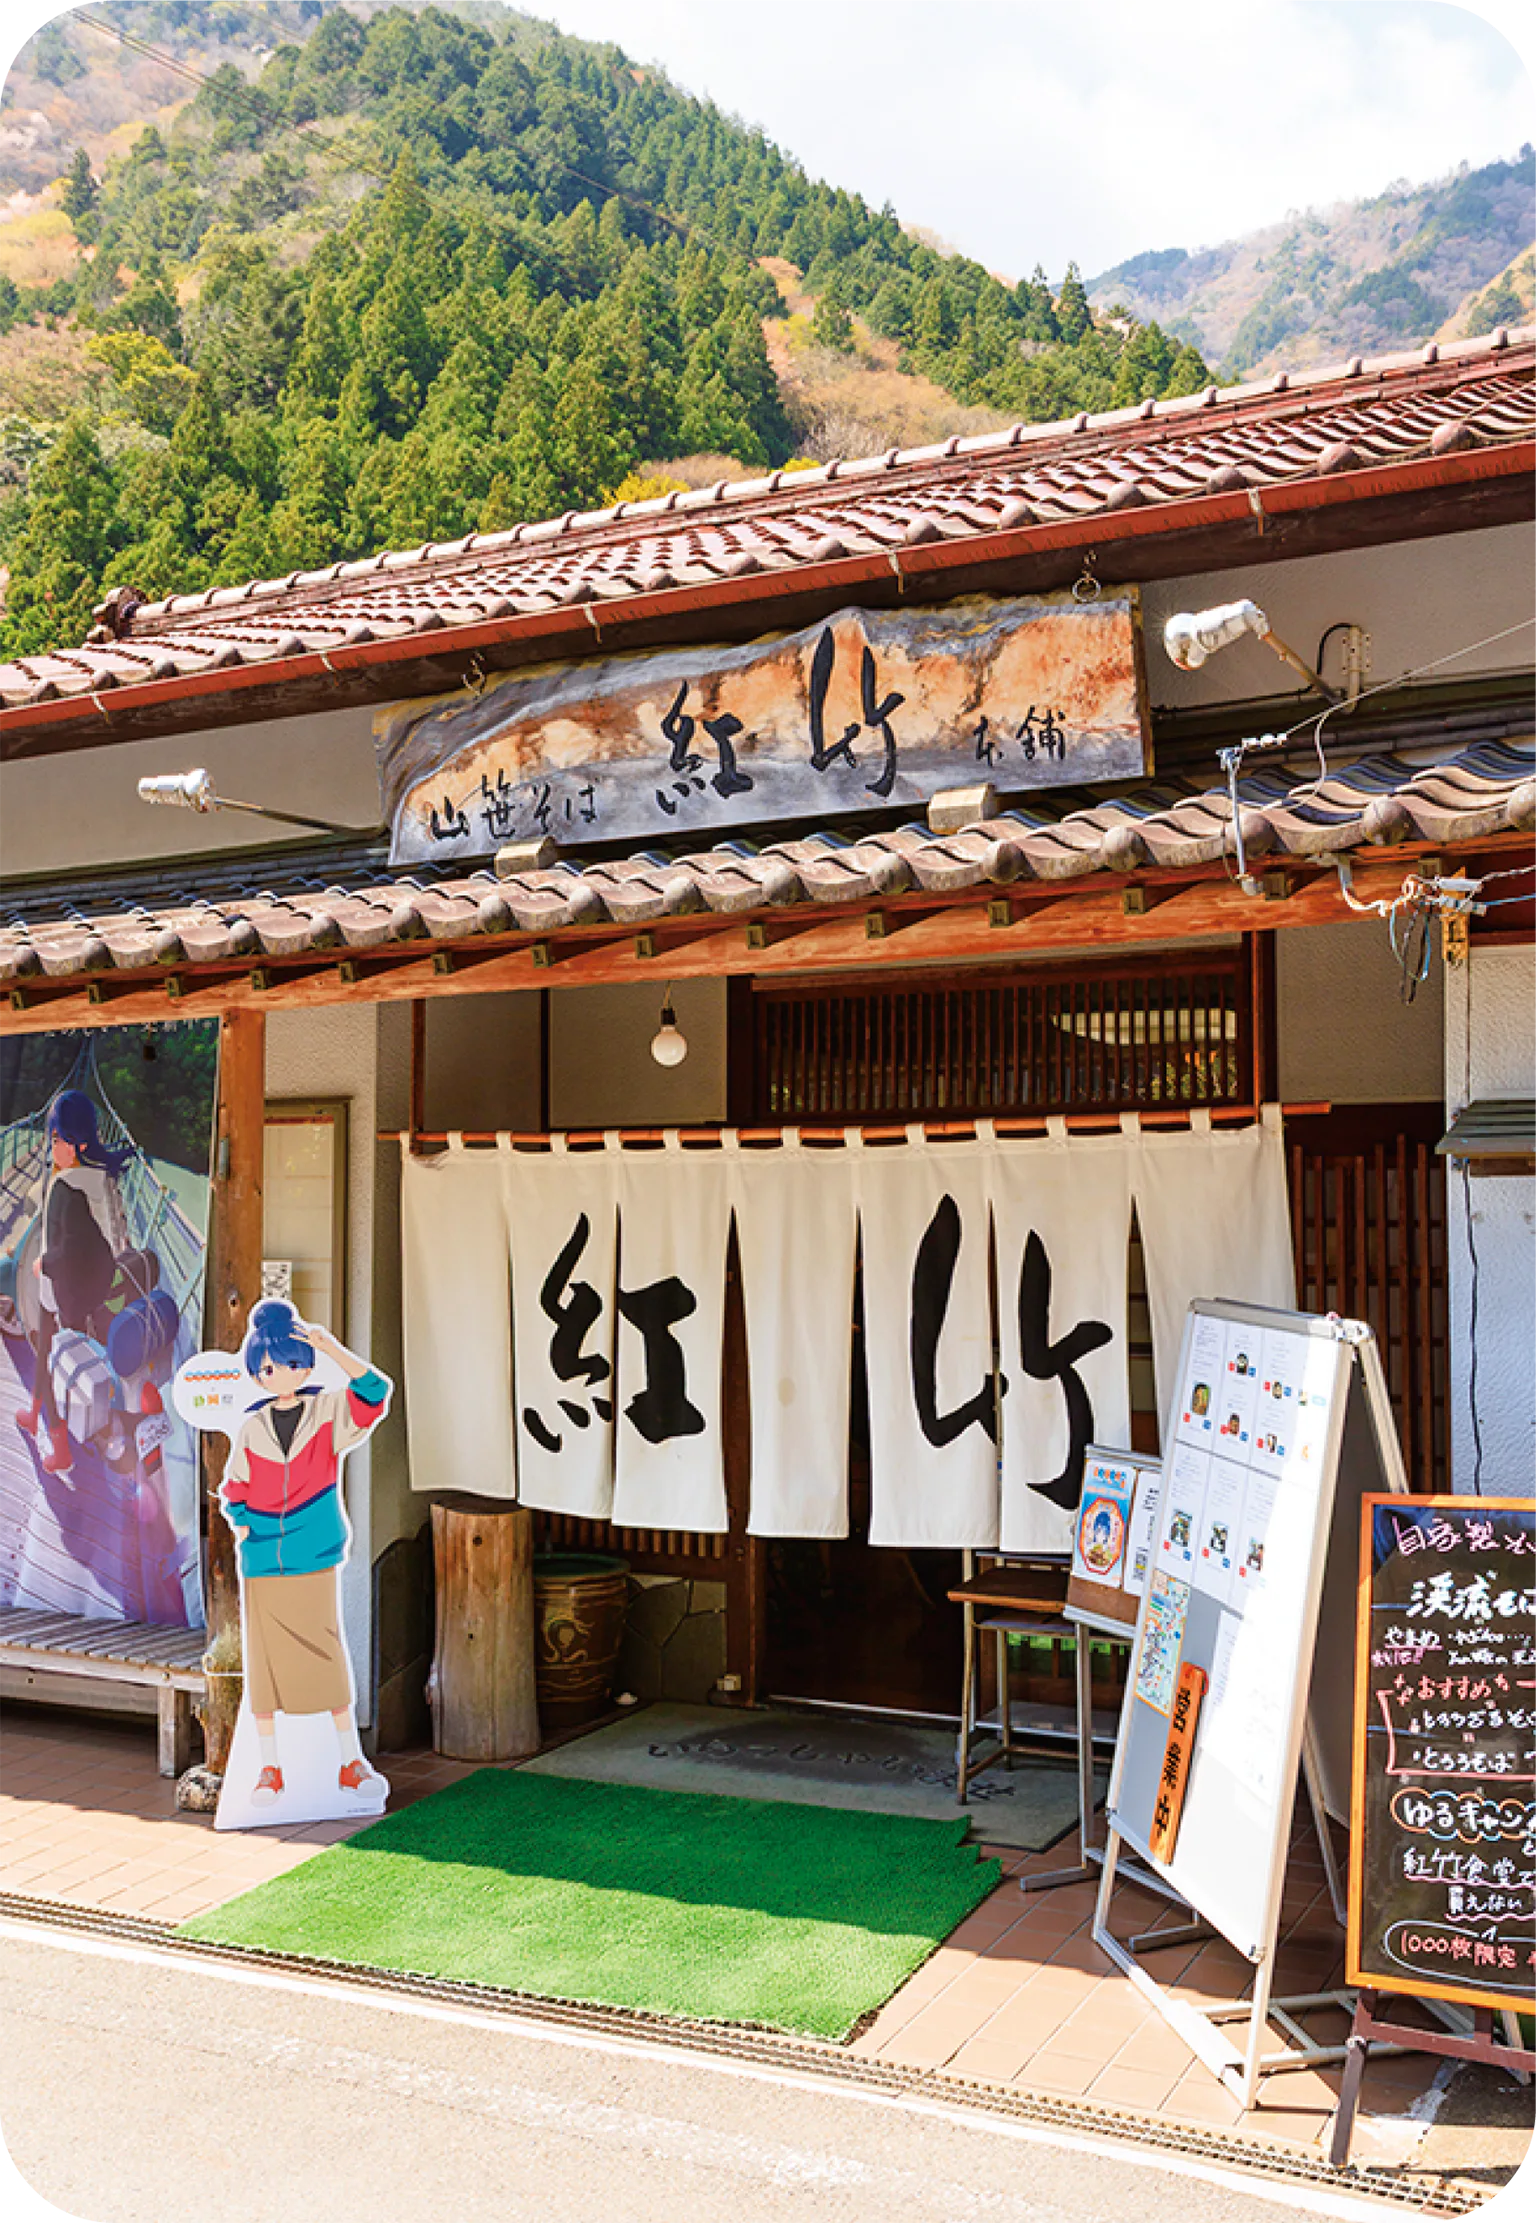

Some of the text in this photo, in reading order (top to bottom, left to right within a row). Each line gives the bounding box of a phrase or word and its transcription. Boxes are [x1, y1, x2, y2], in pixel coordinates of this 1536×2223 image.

[655, 624, 907, 816] 紅竹
[522, 1192, 1114, 1512] 紅竹
[1417, 1674, 1492, 1700] おすすめ
